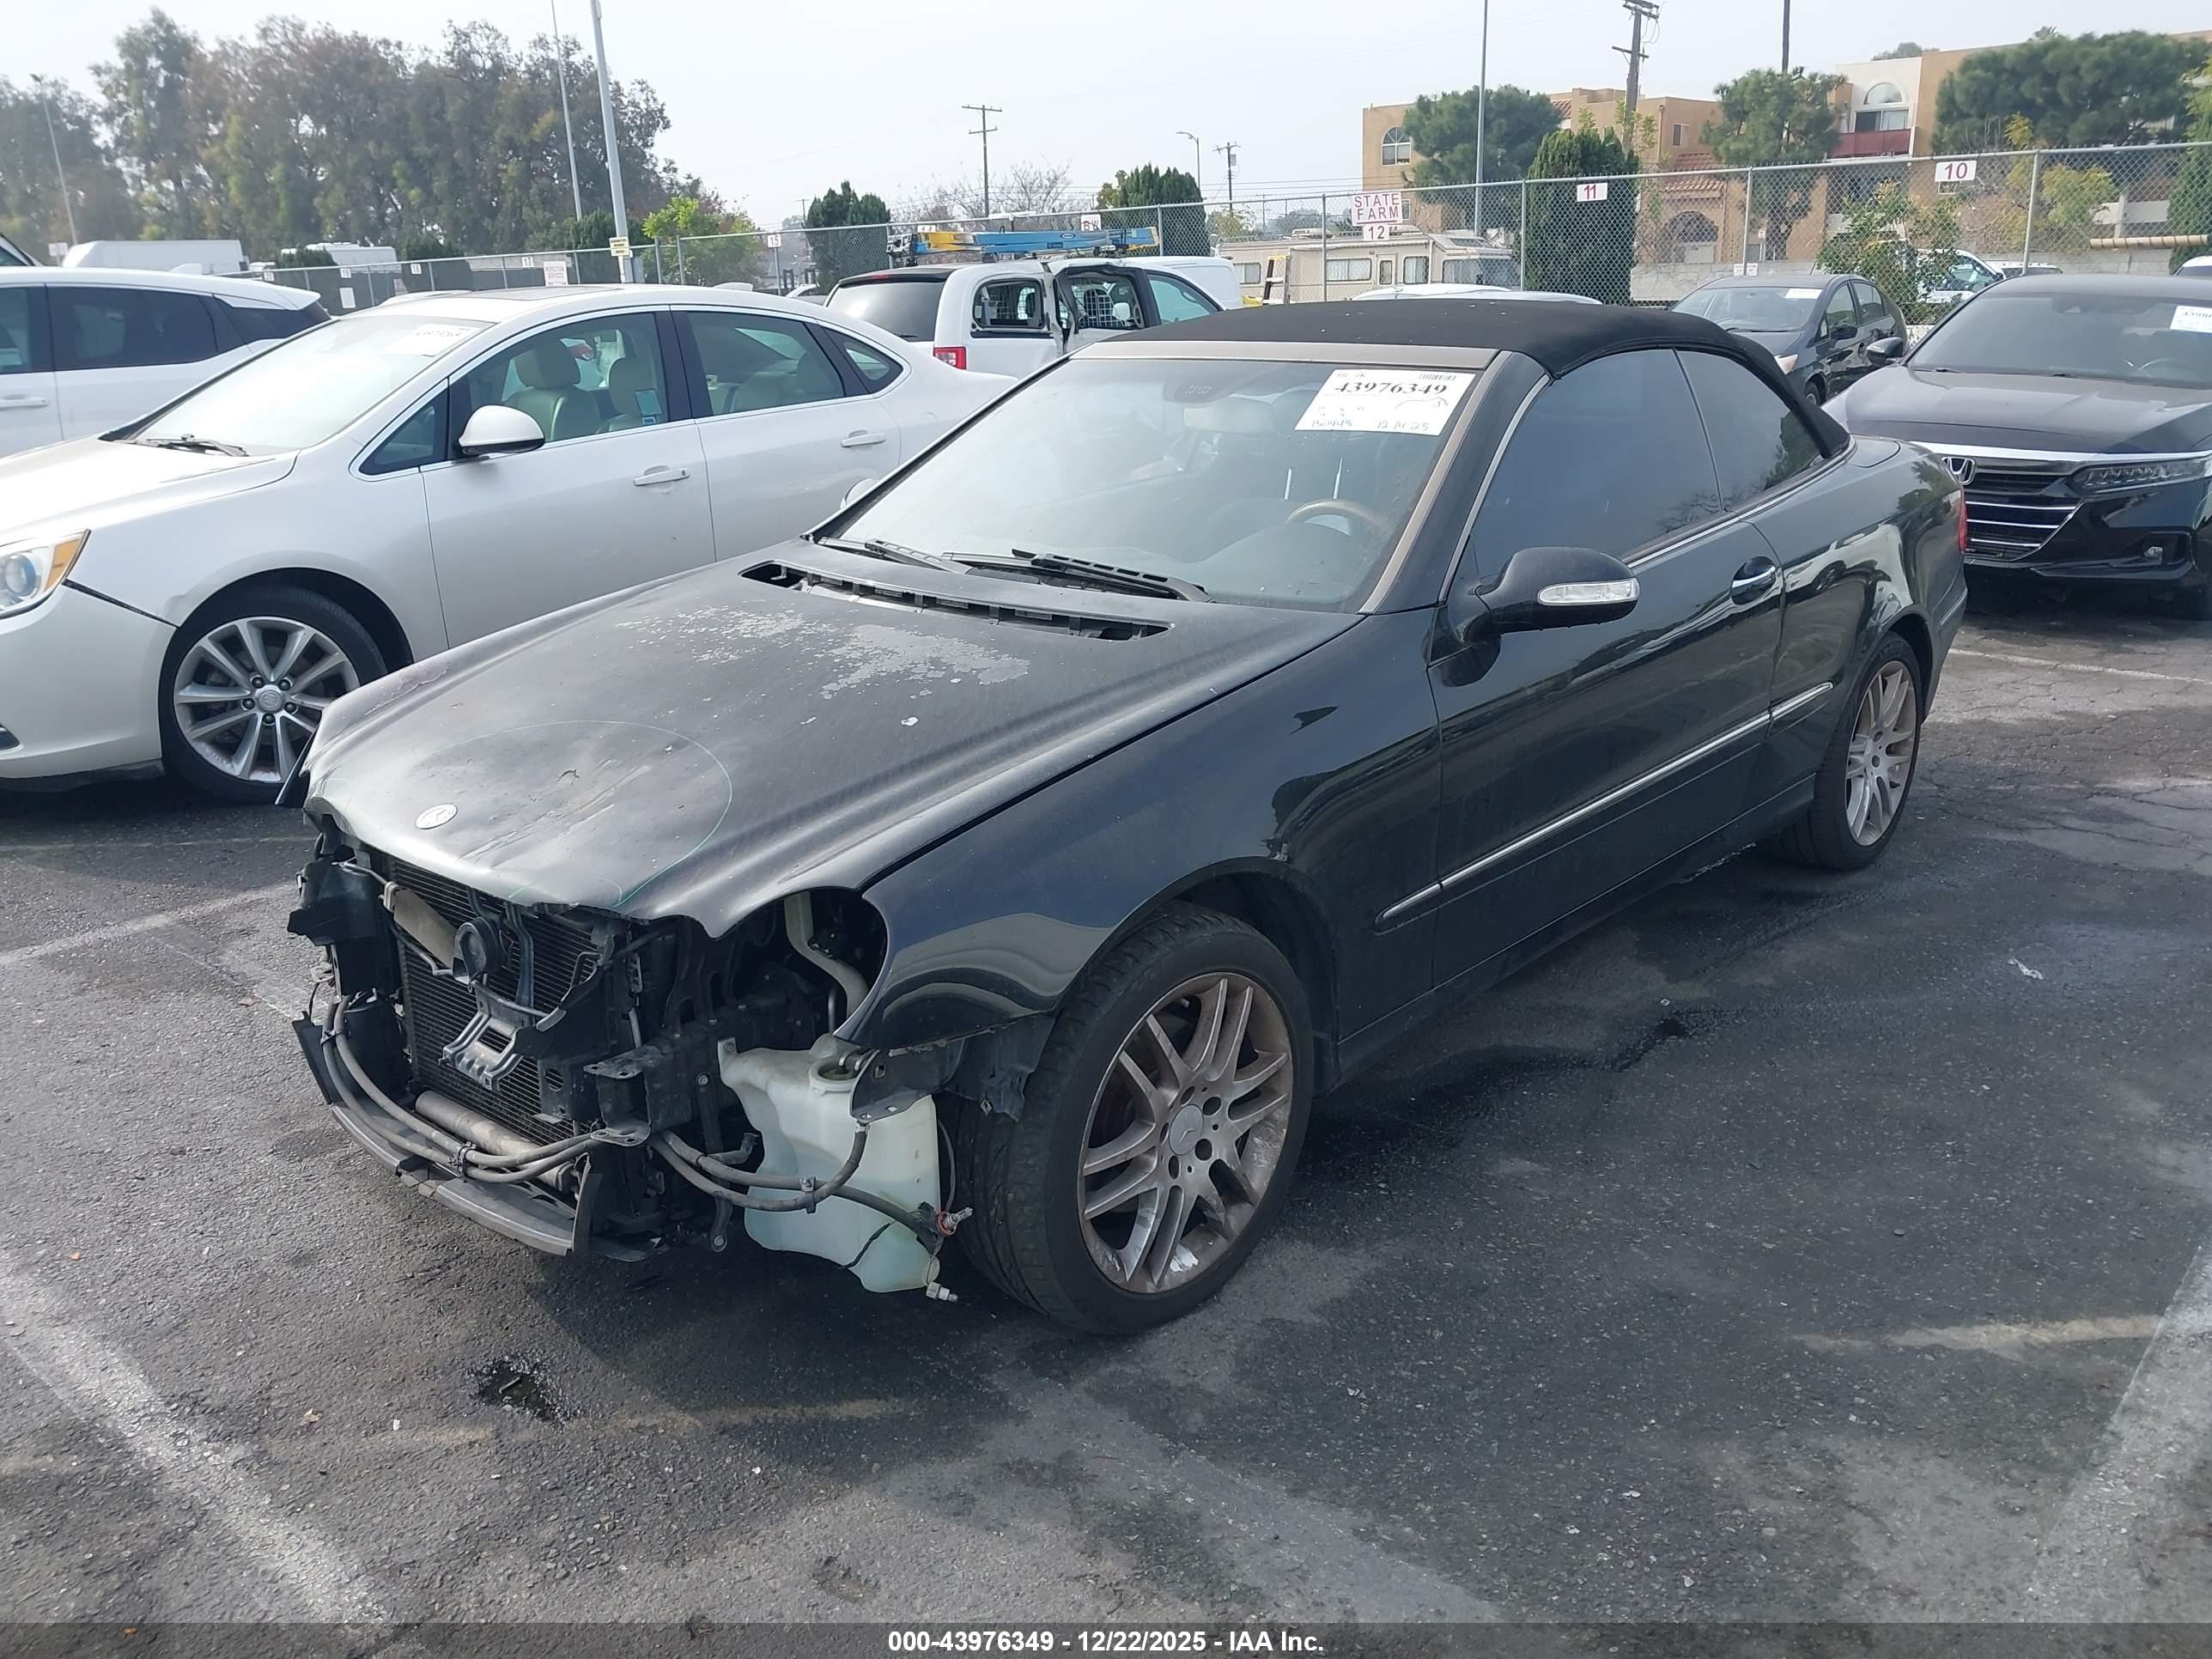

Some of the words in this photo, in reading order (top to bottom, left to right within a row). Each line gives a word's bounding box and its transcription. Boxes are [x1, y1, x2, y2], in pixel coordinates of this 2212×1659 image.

[1944, 162, 1968, 180] 10
[1354, 192, 1400, 208] STATE
[1583, 184, 1596, 200] 11
[1357, 205, 1399, 221] FARM
[1368, 225, 1385, 240] 12
[1334, 382, 1448, 394] 43976349
